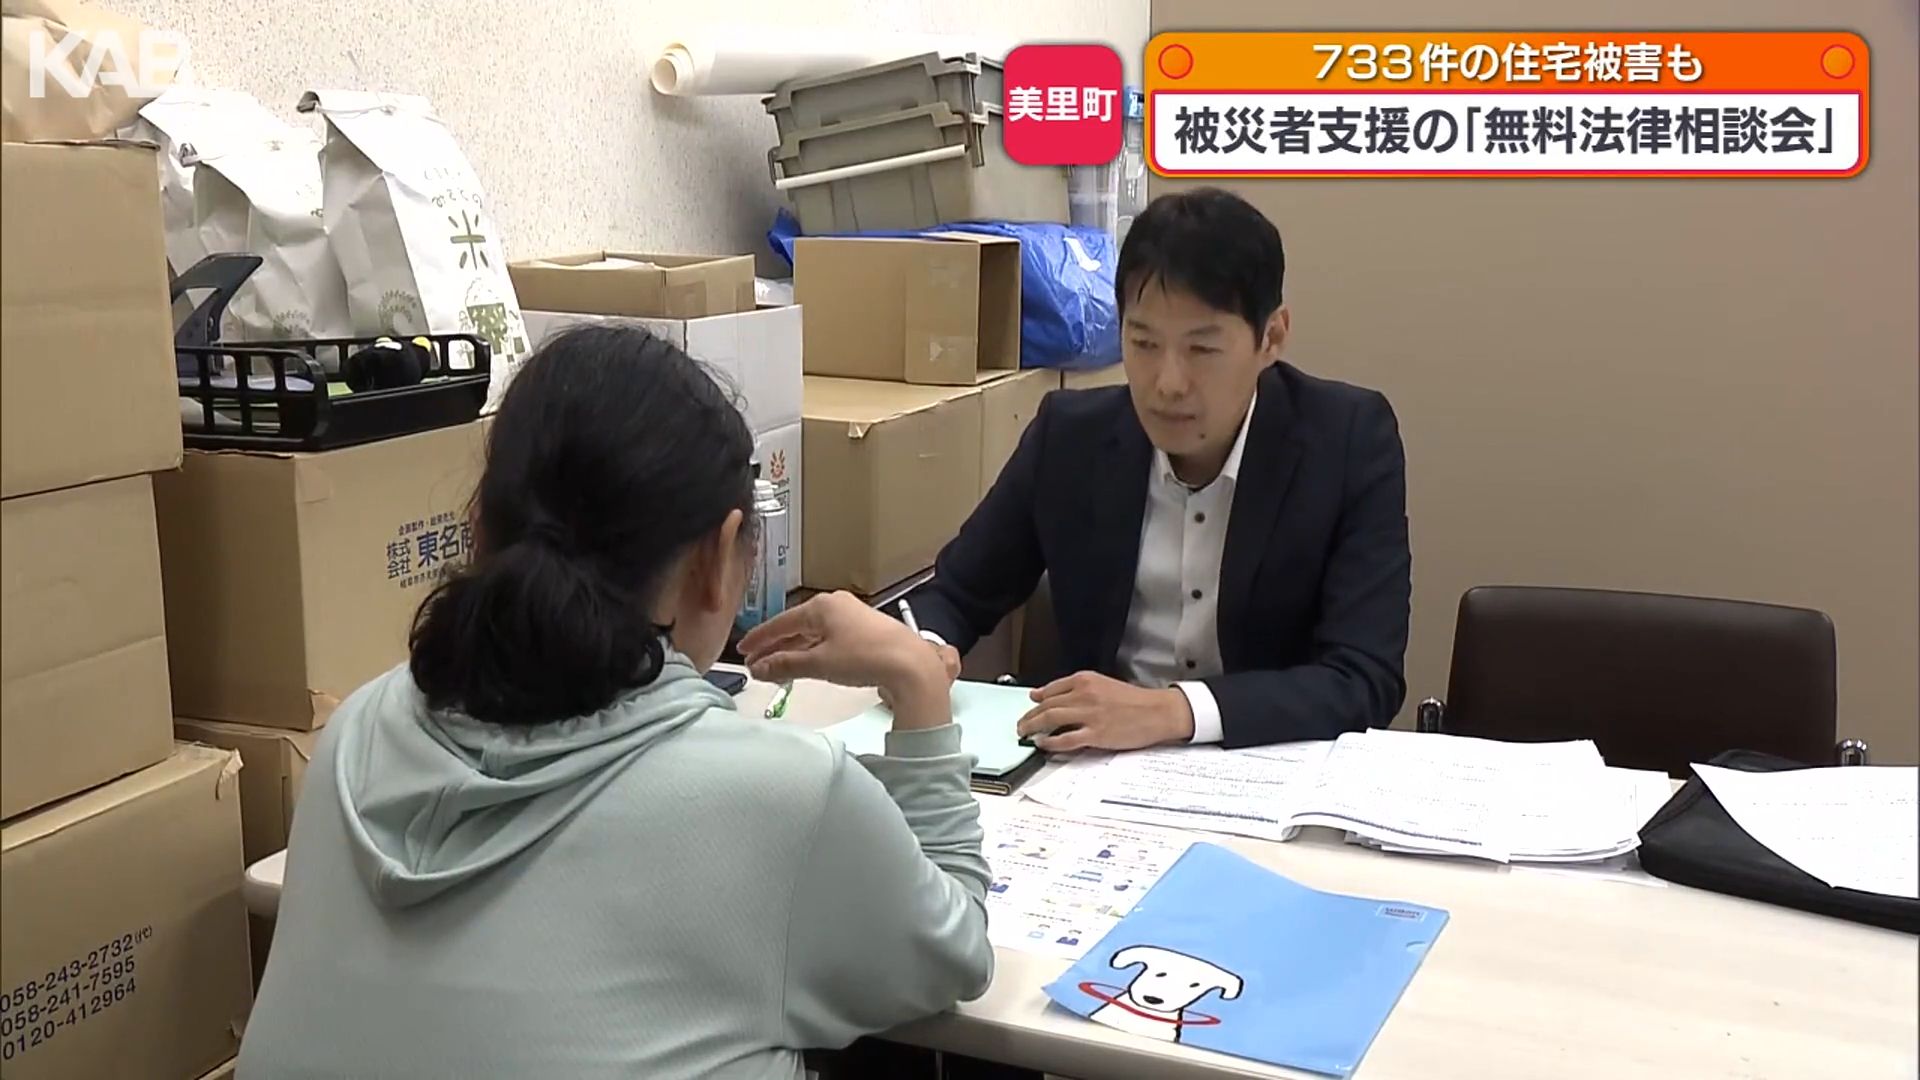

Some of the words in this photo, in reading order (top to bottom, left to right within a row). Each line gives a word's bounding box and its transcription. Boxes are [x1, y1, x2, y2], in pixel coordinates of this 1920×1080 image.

[447, 208, 489, 271] 米
[386, 537, 412, 560] 株式
[386, 556, 412, 579] 会社
[1, 955, 135, 1037] 058-241-7595
[3, 977, 136, 1060] 0120-412964
